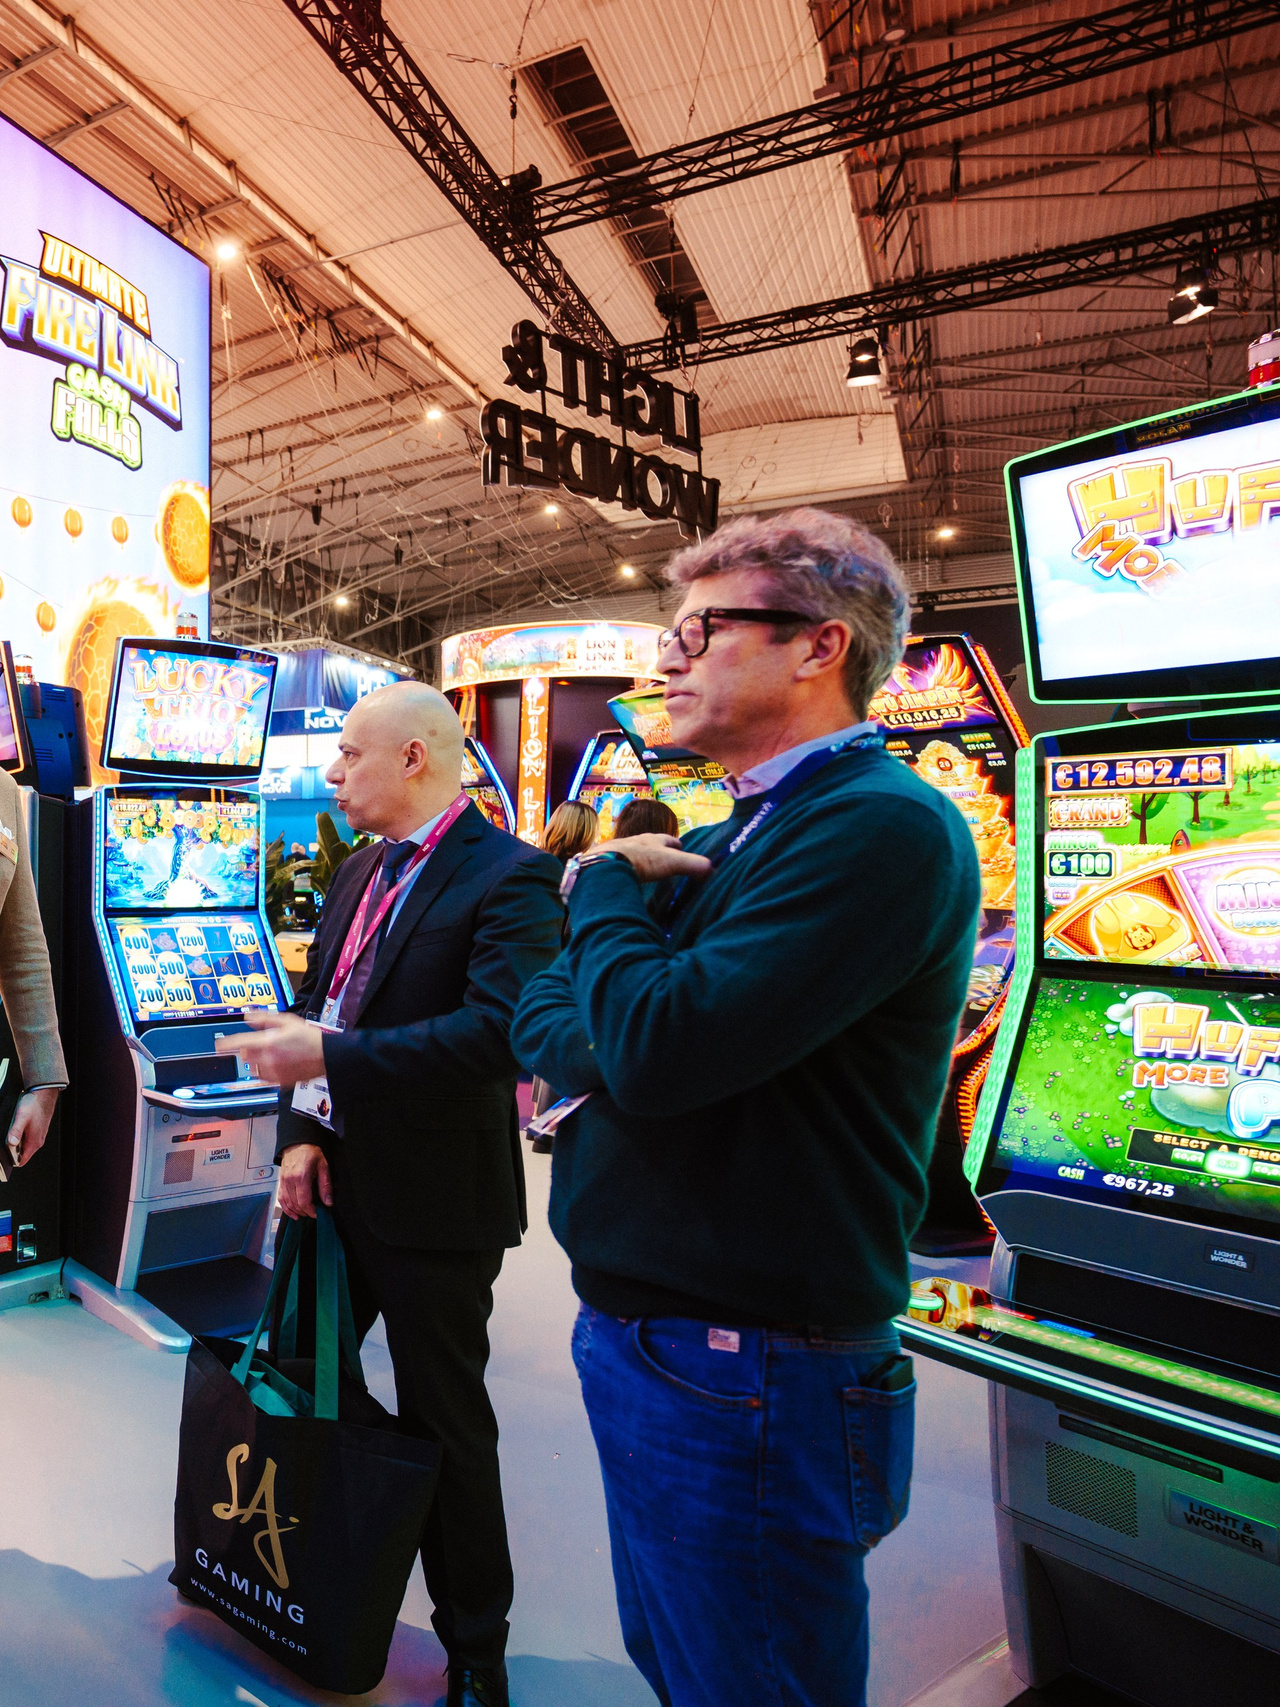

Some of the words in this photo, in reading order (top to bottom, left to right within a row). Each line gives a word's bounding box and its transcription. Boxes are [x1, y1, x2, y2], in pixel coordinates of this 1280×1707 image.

[40, 233, 151, 336] ULTIMATE
[2, 258, 100, 362] FIRE
[101, 302, 184, 417] LINK
[66, 363, 130, 414] CASH
[54, 381, 141, 468] FALLS
[586, 639, 616, 649] LION
[586, 652, 616, 662] LINK
[129, 659, 269, 705] LUCKY
[154, 693, 236, 724] TRIO
[888, 707, 959, 725] €10.016,25
[155, 722, 229, 753] LOTUS
[522, 692, 546, 778] LION
[1055, 756, 1222, 789] €12.592,48
[1053, 802, 1124, 823] GRAND
[1047, 835, 1099, 850] MINOR
[1050, 853, 1111, 876] €100
[124, 935, 150, 950] 400
[179, 934, 205, 948] 1200
[233, 932, 257, 947] 250
[131, 964, 157, 976] 4000
[159, 961, 185, 976] 500
[218, 956, 234, 973] K
[247, 955, 257, 971] J
[137, 988, 164, 1003] 200
[167, 986, 192, 1002] 500
[199, 982, 217, 1002] Q
[222, 984, 247, 999] 400
[247, 982, 272, 997] 250
[1134, 1061, 1228, 1088] MORE
[209, 1153, 231, 1162] WONDER
[1153, 1133, 1210, 1151] SELECT
[1218, 1144, 1229, 1153] A
[1057, 1165, 1086, 1181] CASH
[1102, 1173, 1175, 1198] €967,25
[1210, 1254, 1247, 1269] WONDER
[1213, 1249, 1237, 1260] LIGHT
[1237, 1253, 1244, 1261] &
[1183, 1511, 1265, 1553] WONDER
[1189, 1502, 1240, 1530] LIGHT
[1241, 1521, 1256, 1537] &
[195, 1547, 305, 1625] GAMING
[190, 1576, 308, 1656] www.sagaming.com
